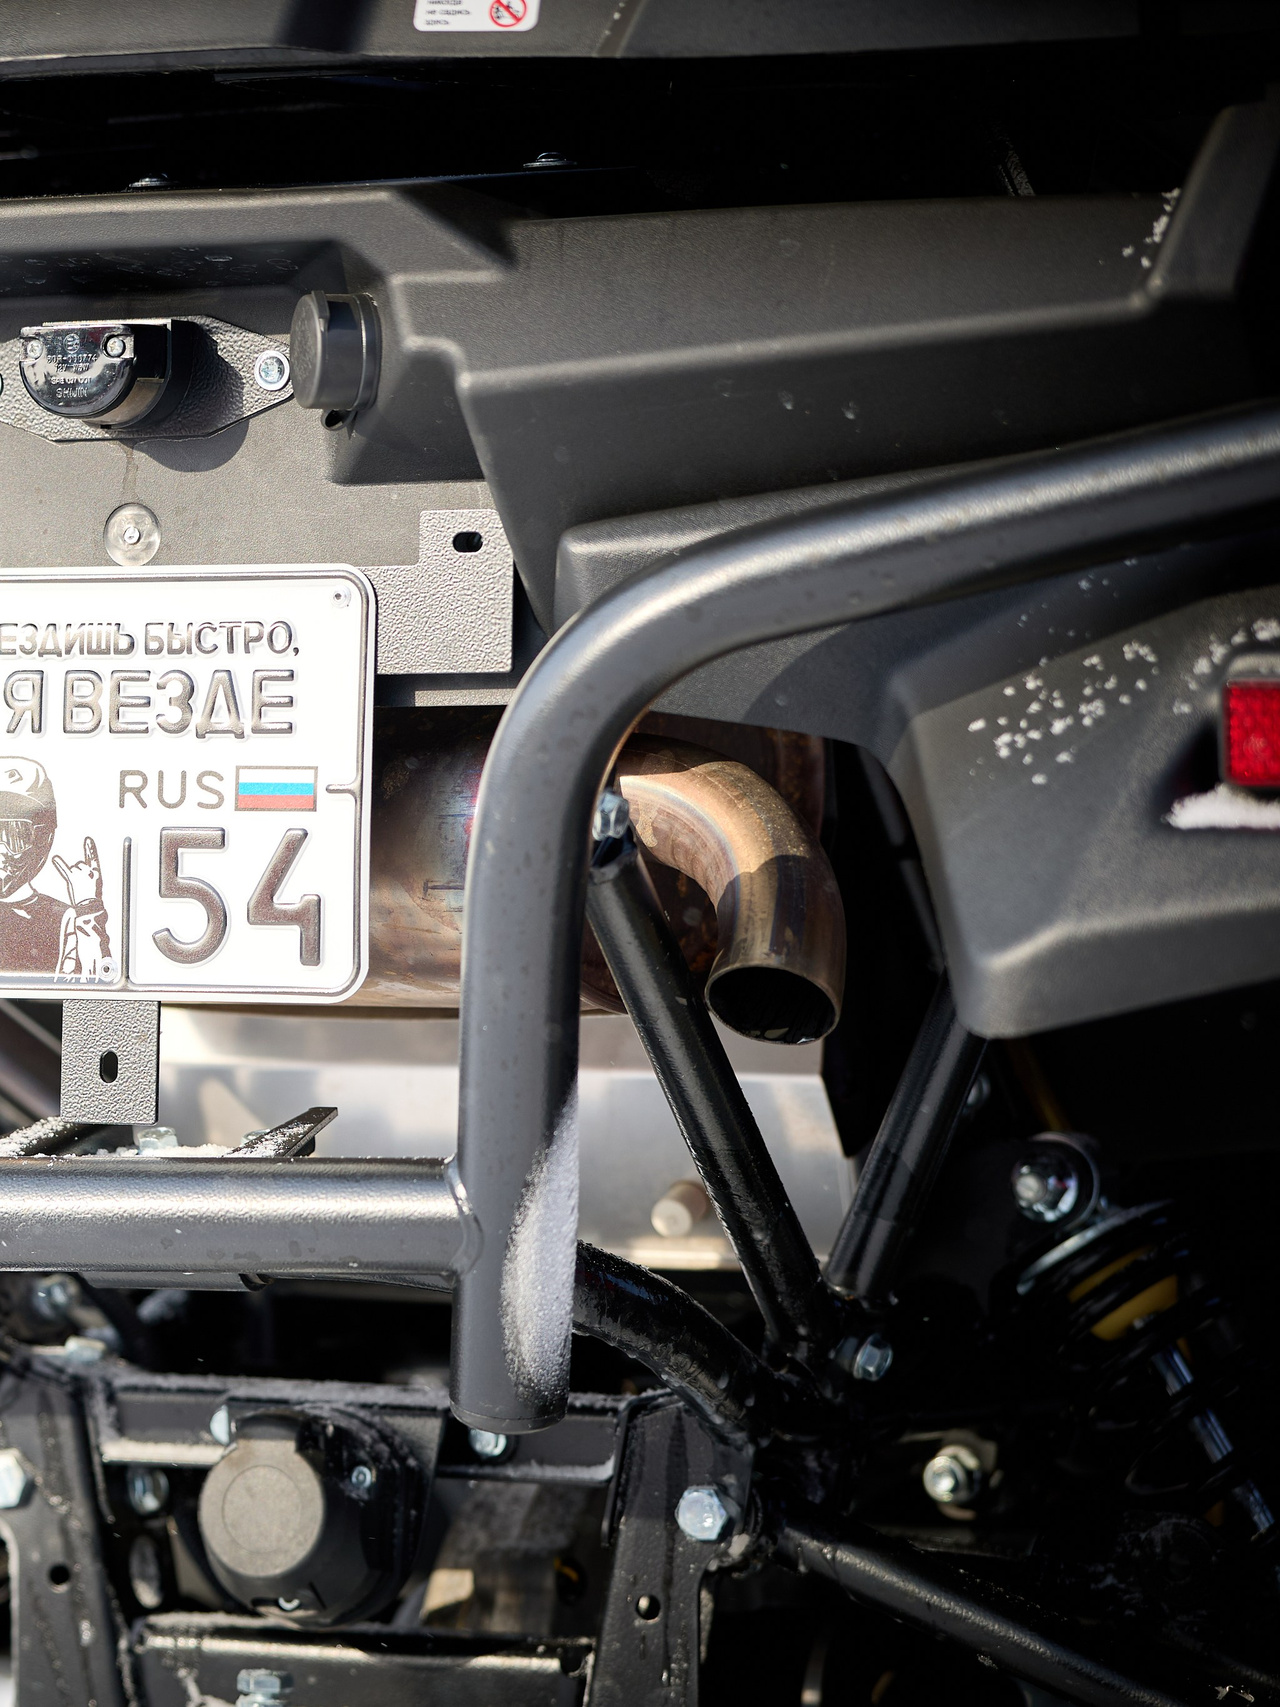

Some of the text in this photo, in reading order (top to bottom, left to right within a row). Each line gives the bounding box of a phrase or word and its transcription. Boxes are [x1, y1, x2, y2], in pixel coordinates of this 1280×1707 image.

[144, 620, 299, 657] БЫСТРО,
[3, 670, 45, 734] Я
[63, 669, 295, 739] ВЕЗДЕ
[119, 769, 224, 809] RUS
[151, 826, 321, 966] 54
